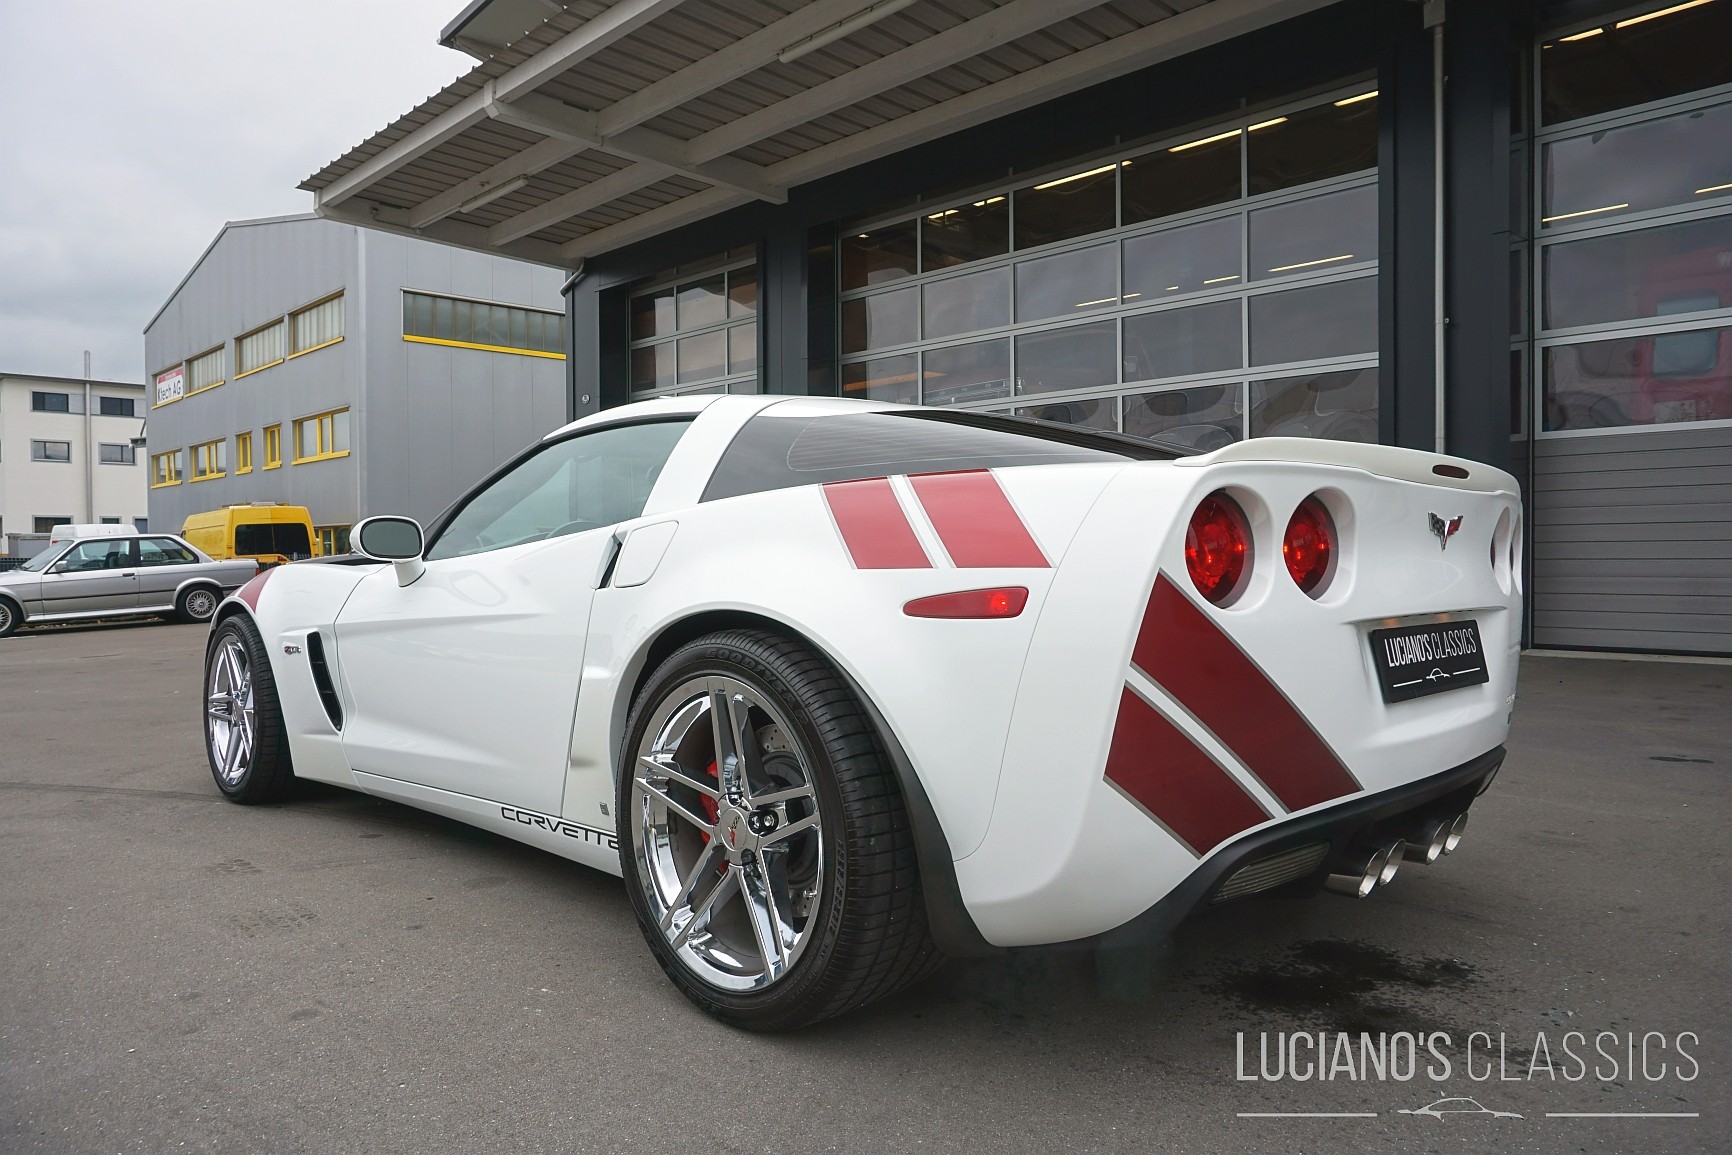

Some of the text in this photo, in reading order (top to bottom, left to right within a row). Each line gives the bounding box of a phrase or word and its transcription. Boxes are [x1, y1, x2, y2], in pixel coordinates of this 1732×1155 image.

[173, 380, 181, 397] AG
[1384, 628, 1477, 667] LUCIANO'S CLASSICS
